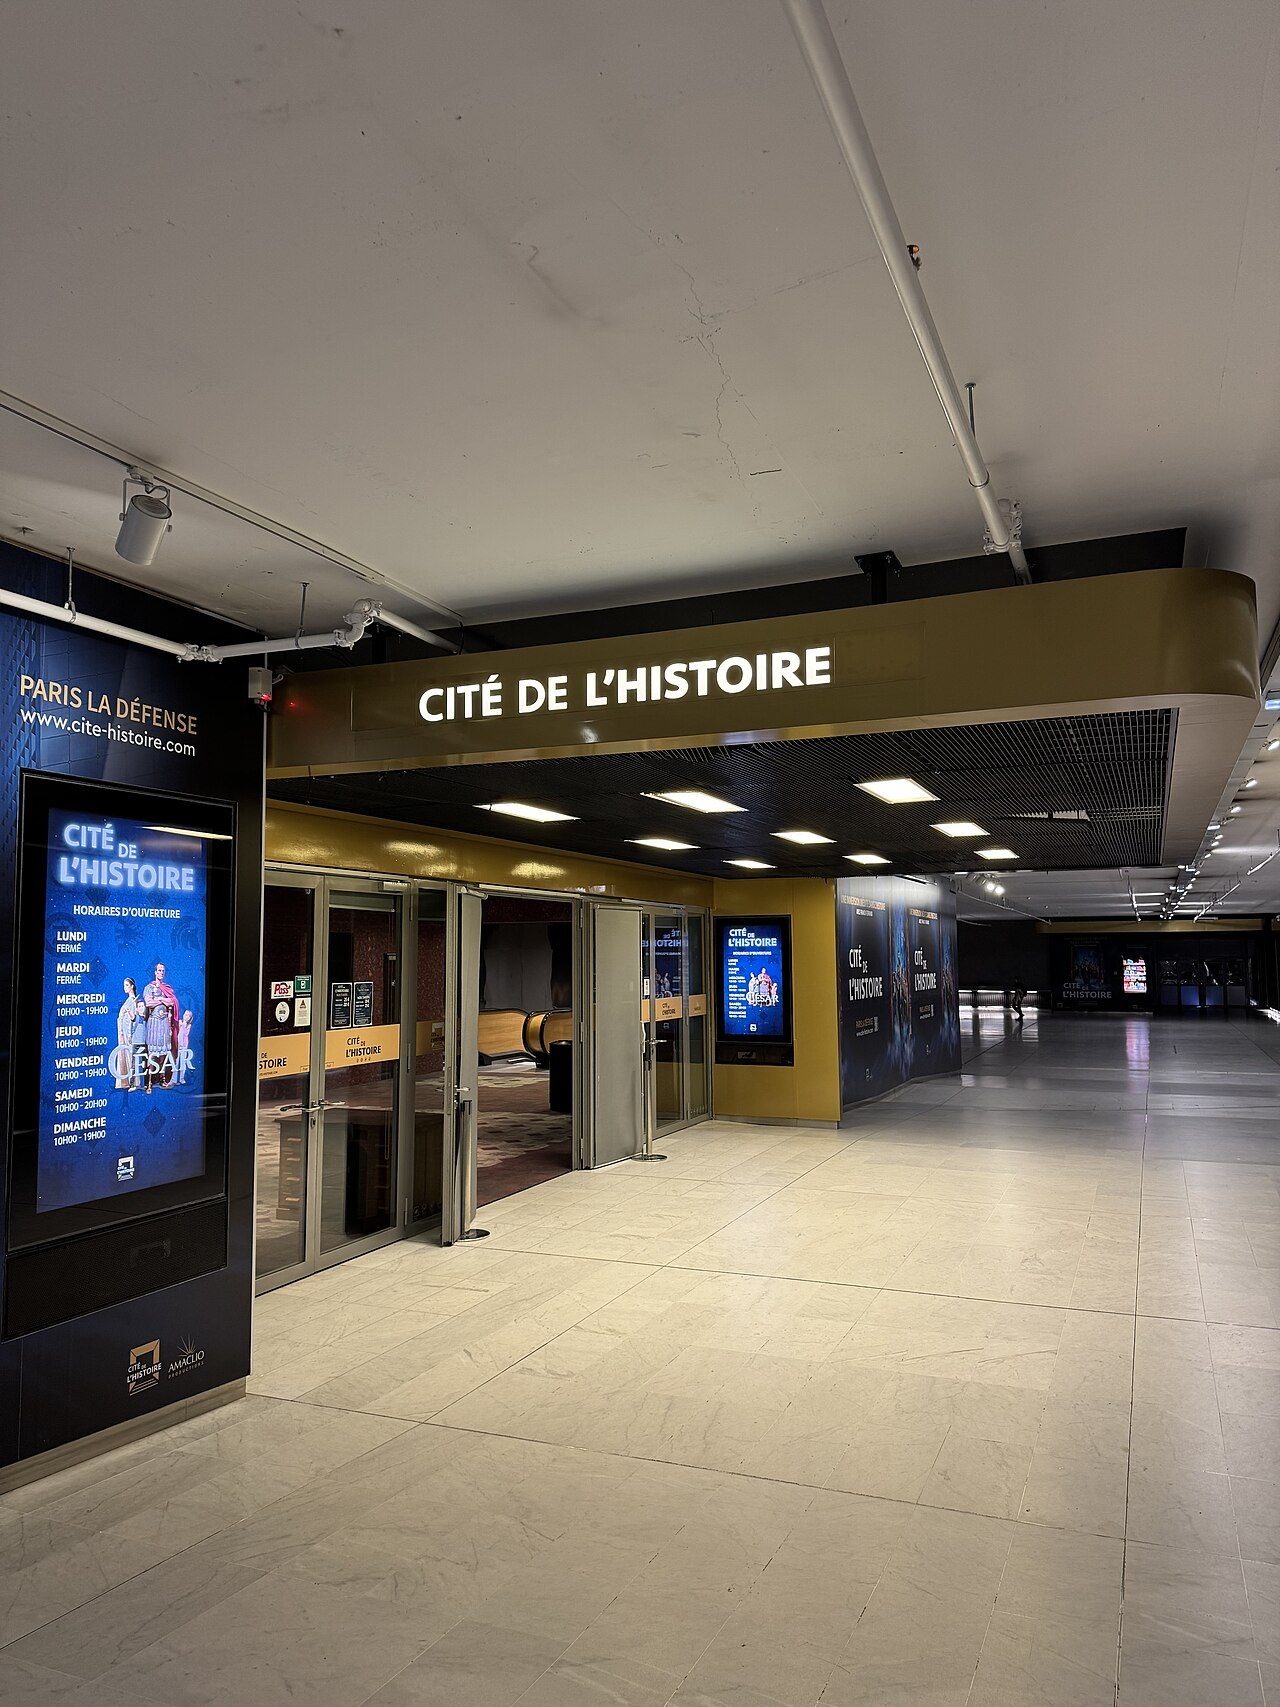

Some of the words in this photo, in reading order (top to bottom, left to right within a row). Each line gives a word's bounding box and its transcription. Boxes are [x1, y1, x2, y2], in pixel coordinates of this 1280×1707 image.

[418, 674, 503, 722] CITÉ
[517, 675, 568, 714] DE
[586, 646, 831, 707] L'HISTOIRE
[20, 674, 82, 709] PARIS
[87, 690, 112, 716] LA
[116, 697, 198, 735] DÉFENSE
[20, 708, 196, 757] www.cite-histoire.com
[63, 822, 115, 850] CITÉ
[118, 842, 137, 859] DE
[60, 857, 194, 891] L'HISTOIRE
[73, 905, 120, 917] HORAIRES
[121, 907, 181, 919] D'OUVERTURE
[57, 931, 87, 941] LUNDI
[729, 927, 747, 937] CITÉ
[56, 943, 82, 953] FERMÉ
[728, 938, 777, 947] L'HISTOIRE
[849, 945, 862, 968] CITÉ
[56, 962, 90, 972] MARDI
[56, 974, 82, 985] FERMÉ
[849, 976, 883, 1001] L'HISTOIRE
[56, 993, 106, 1005] MERCREDI
[56, 1007, 80, 1016] 10H00
[85, 1006, 108, 1015] 19H00
[55, 1026, 82, 1039] JEUDI
[56, 1039, 80, 1049] 10H00
[85, 1036, 108, 1047] 19H00
[346, 1036, 360, 1046] CITÉ
[345, 1045, 382, 1058] L'HISTOIRE
[55, 1055, 104, 1069] VENDREDI
[55, 1071, 79, 1081] 10H00
[85, 1068, 107, 1078] 19H00
[55, 1087, 93, 1101] SAMEDI
[55, 1102, 79, 1114] 10H00
[84, 1098, 108, 1110] 20H00
[53, 1116, 107, 1135] DIMANCHE
[53, 1134, 78, 1146] 10H00
[83, 1130, 106, 1141] 19H00
[127, 1361, 141, 1373] CITÉ
[168, 1350, 205, 1373] AMACLIO
[126, 1362, 162, 1383] L'HISTOIRE
[168, 1361, 204, 1379] PRODUCTIONS
